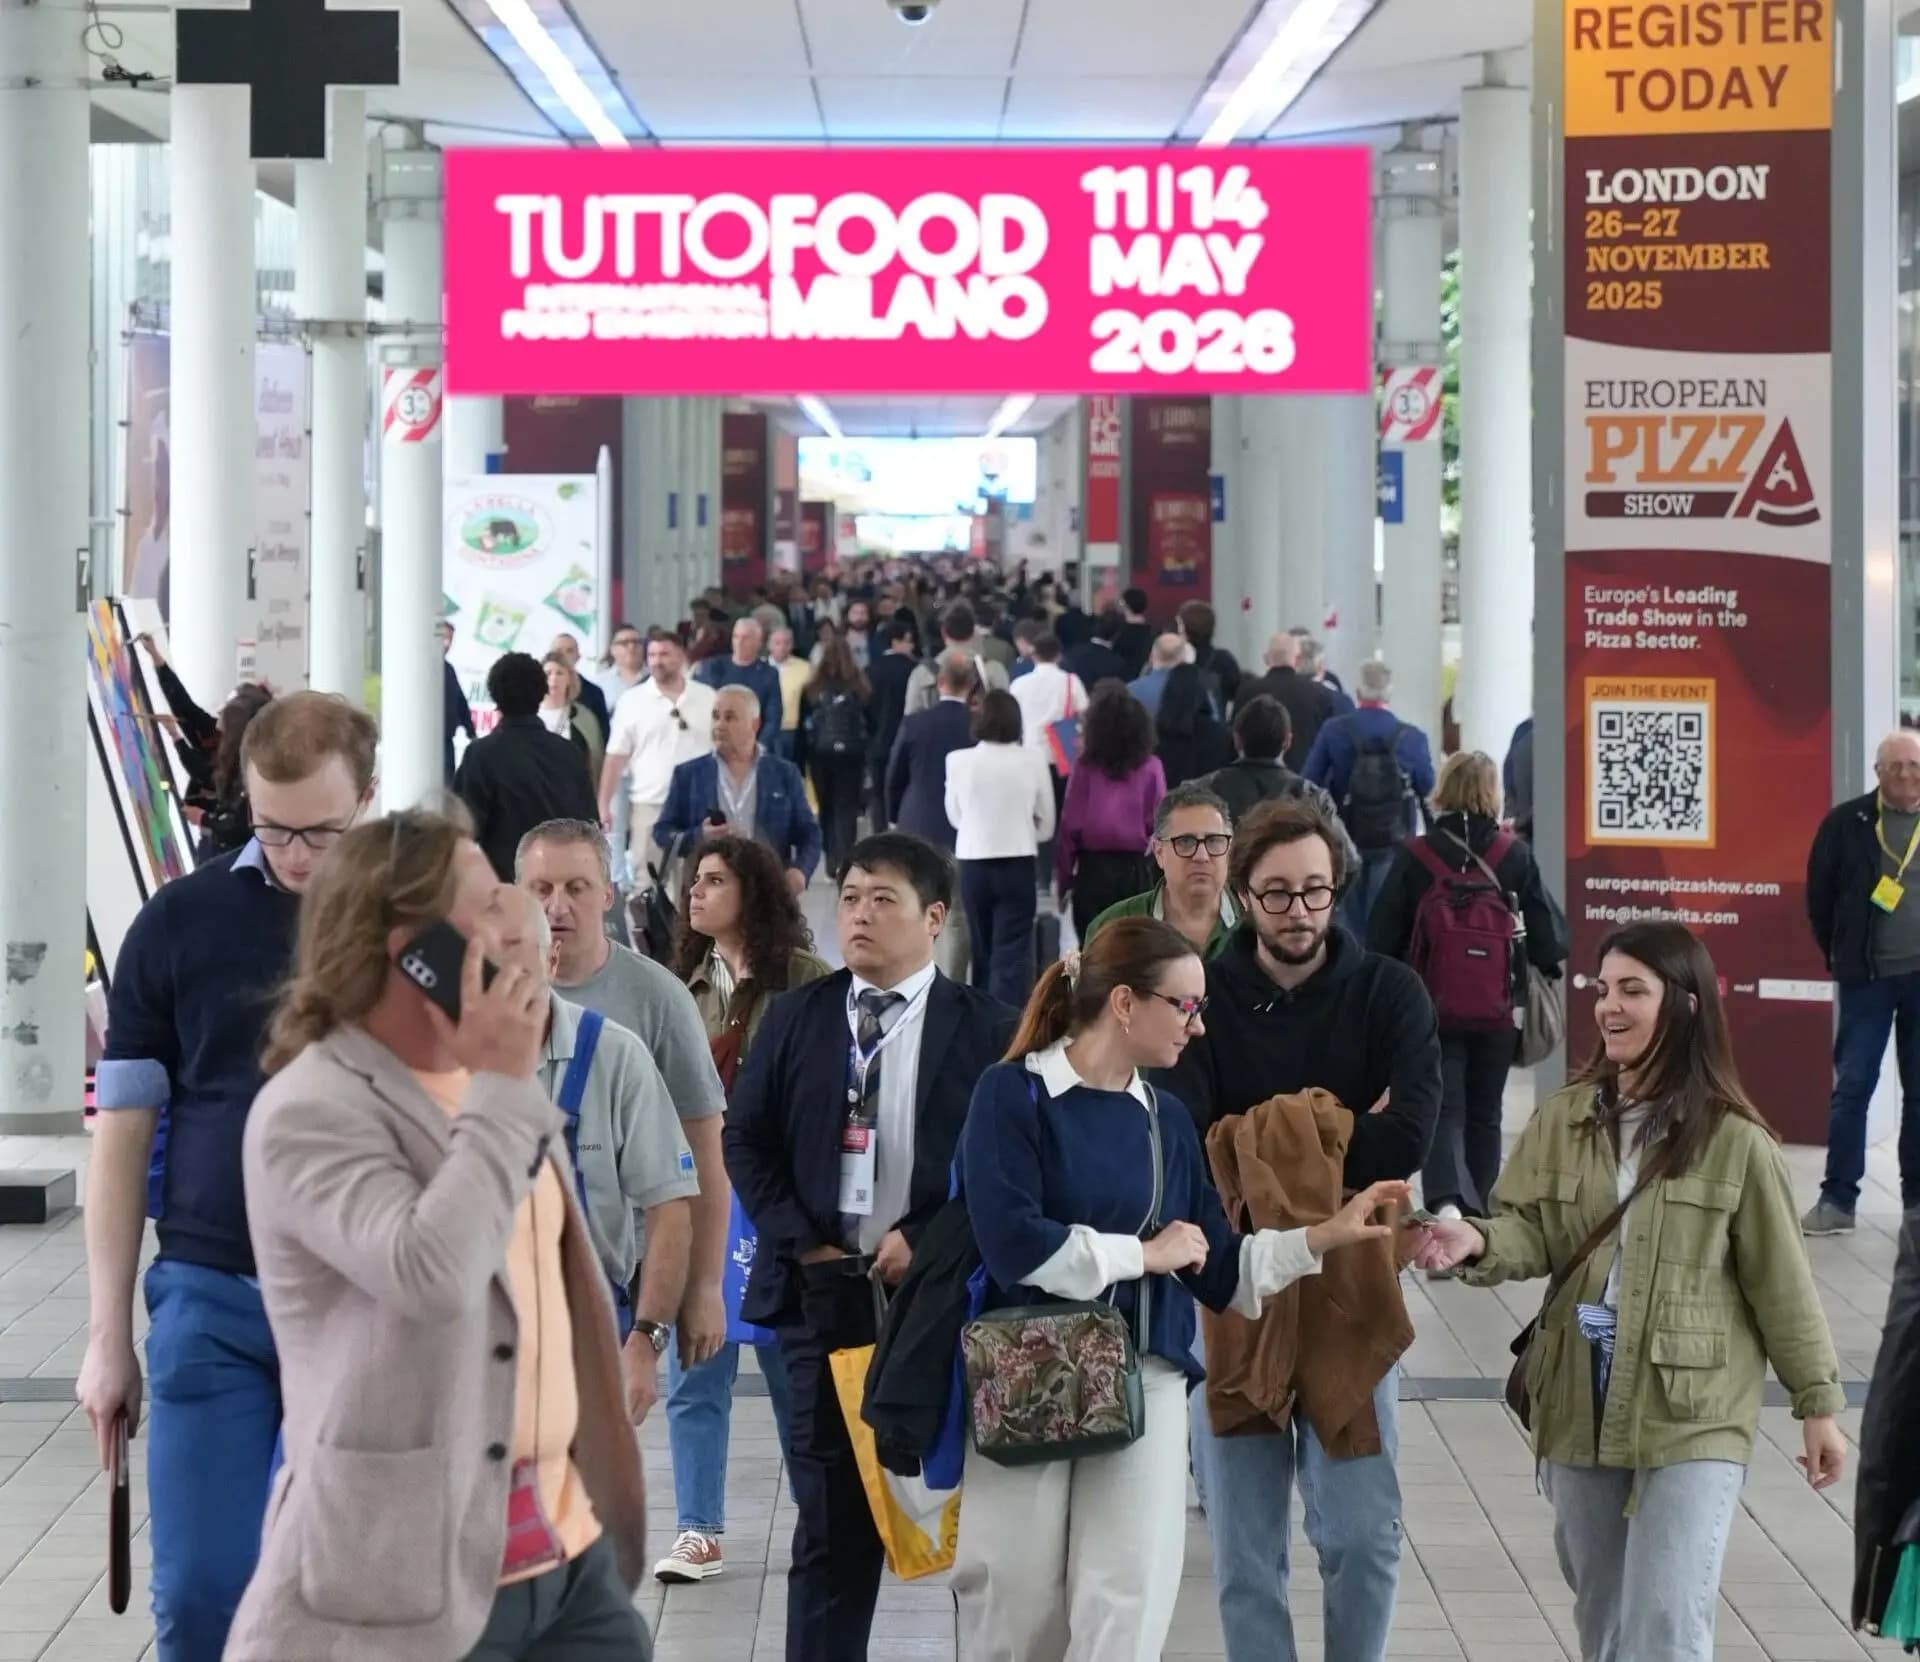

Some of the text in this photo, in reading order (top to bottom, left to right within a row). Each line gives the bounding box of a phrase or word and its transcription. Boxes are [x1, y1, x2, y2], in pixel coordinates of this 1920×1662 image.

[1573, 0, 1823, 50] REGISTER
[1605, 64, 1789, 113] TODAY
[1585, 165, 1770, 203] LONDON
[494, 192, 1049, 278] TUTTOFOOD
[1089, 233, 1264, 296] MAY
[1585, 243, 1771, 272] NOVEMBER
[769, 274, 1049, 340] MILANO
[1586, 281, 1663, 310] 2025
[1585, 379, 1767, 408] EUROPEAN
[1623, 493, 1695, 516] SHOW
[1585, 586, 1738, 608] Europe's Leading
[1585, 608, 1747, 627] Trade Show in the
[1585, 630, 1701, 648] Pizza Sector.
[1592, 683, 1708, 698] JOIN THE EVENT
[1585, 877, 1780, 896] europeanpizzashow.com
[1585, 904, 1739, 924] info@bellavita.com
